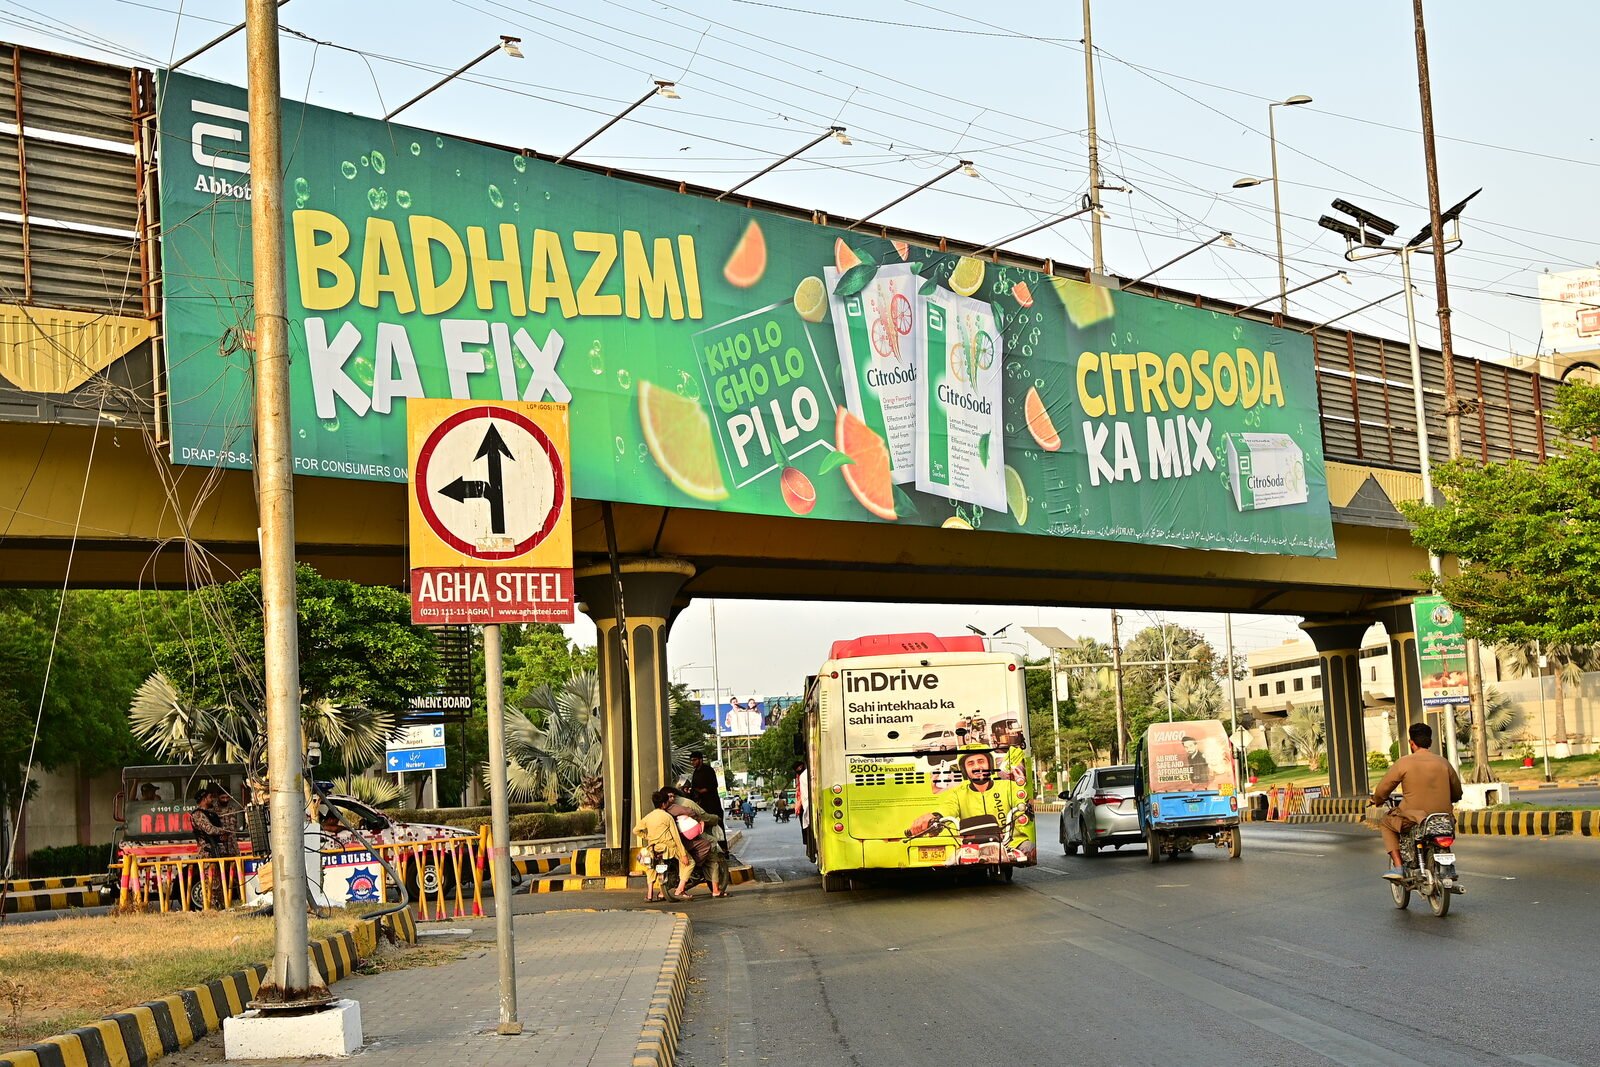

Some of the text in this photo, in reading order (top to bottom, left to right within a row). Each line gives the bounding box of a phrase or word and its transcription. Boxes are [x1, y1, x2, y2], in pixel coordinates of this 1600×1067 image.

[194, 174, 251, 200] Abbot
[293, 209, 703, 320] BADHAZMI
[704, 320, 782, 376] KHO LO
[305, 316, 572, 419] KA FIX
[715, 347, 804, 413] GHO LO
[1076, 348, 1284, 417] CITROSODA
[938, 384, 992, 415] CitroSoda
[727, 386, 819, 468] PI LO
[1083, 414, 1217, 486] KA MIX
[295, 457, 318, 471] FOR
[321, 459, 391, 478] CONSUMERS
[392, 467, 408, 479] ON
[1247, 473, 1284, 490] CitroSoda
[418, 572, 569, 602] AGHA STEEL
[420, 607, 568, 616] (021) 111-11-AGHA www.aghasteel.com
[847, 669, 939, 692] inDrive
[442, 696, 471, 709] BOARD
[849, 699, 955, 713] Sahi intekhaab ka
[849, 714, 913, 725] sahi inaam
[1154, 730, 1185, 743] YANGO
[850, 764, 883, 773] 2500+
[1156, 761, 1171, 769] SAFE
[1158, 766, 1194, 776] AFFORDABLE
[993, 792, 1007, 826] nDrive
[340, 852, 372, 865] RULES
